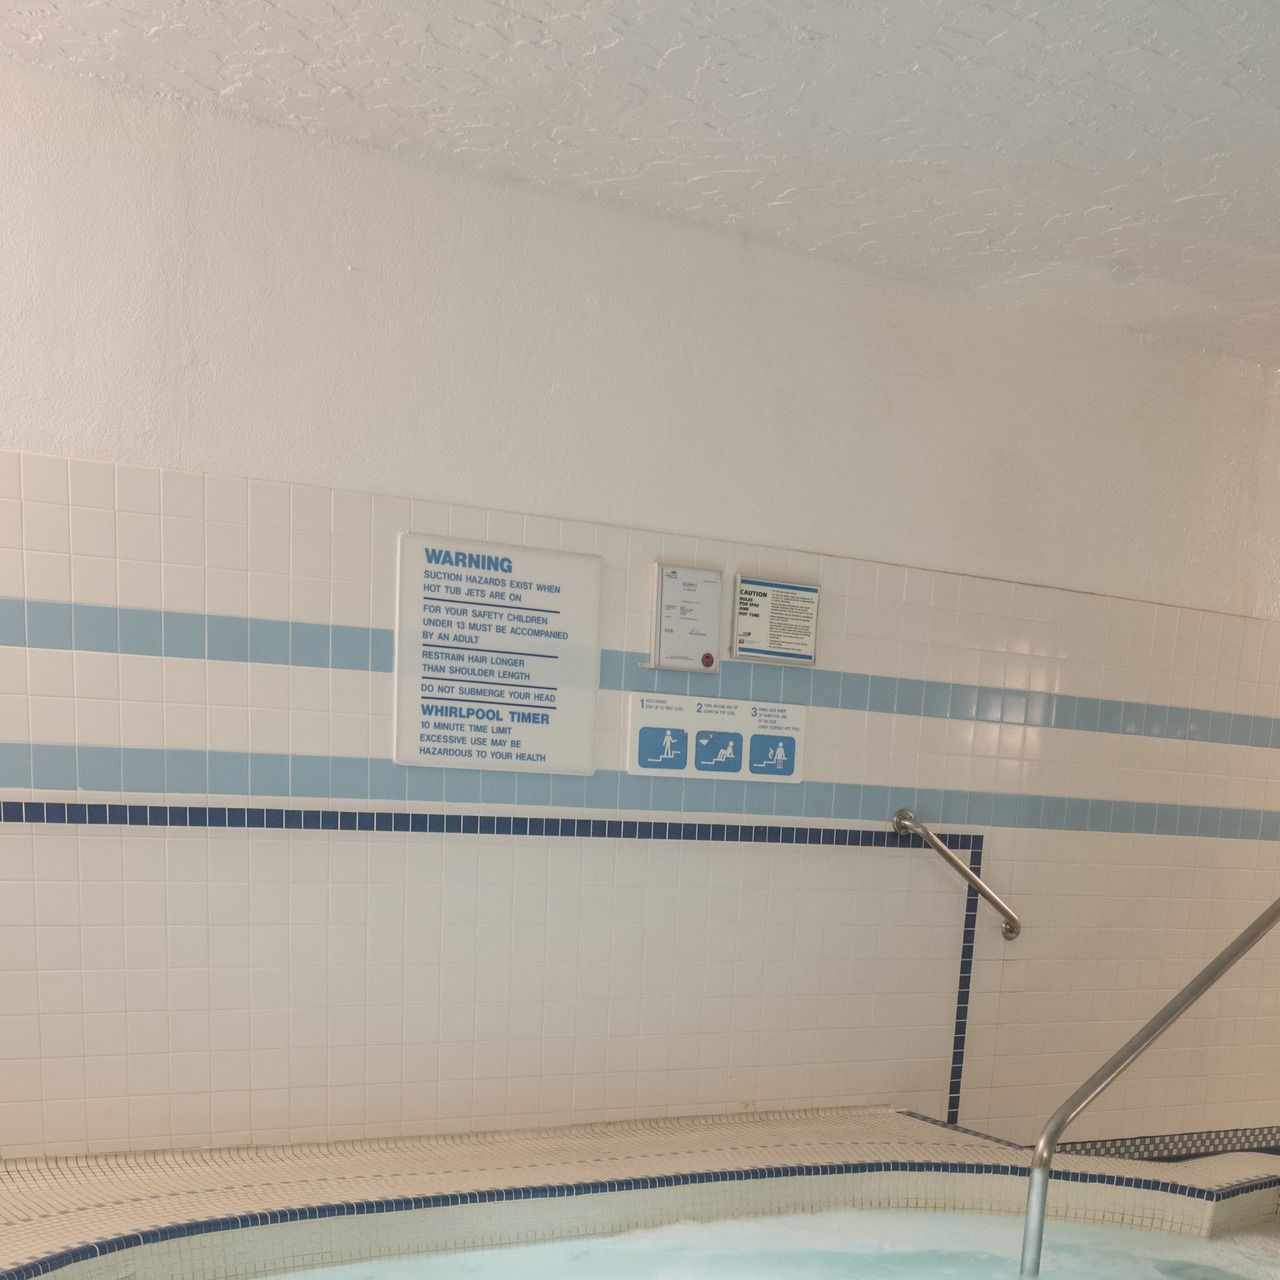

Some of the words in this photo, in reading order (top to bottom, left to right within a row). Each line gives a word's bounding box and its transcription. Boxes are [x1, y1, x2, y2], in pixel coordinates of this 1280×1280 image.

[425, 548, 513, 573] WARNING
[424, 570, 462, 582] SUCTION
[466, 575, 506, 587] HAZARDS
[510, 580, 534, 591] EXIST
[536, 584, 561, 594] WHEN
[424, 584, 440, 593] HOT
[445, 586, 461, 595] TUB
[465, 588, 486, 598] JETS
[489, 591, 505, 600] ARE
[509, 593, 522, 602] ON
[740, 589, 767, 598] CAUTION
[424, 605, 441, 614] FOR
[445, 607, 468, 617] YOUR
[472, 610, 504, 620] SAFETY
[507, 613, 548, 625] CHILDREN
[423, 618, 452, 628] UNDER
[456, 621, 465, 630] 13
[468, 623, 492, 633] MUST
[495, 625, 507, 634] BE
[510, 627, 568, 640] ACCOMPANIED
[423, 631, 435, 639] BY
[437, 632, 450, 641] AN
[453, 634, 479, 644] ADULT
[422, 650, 464, 662] RESTRAIN
[468, 655, 487, 664] HAIR
[491, 657, 525, 667] LONGER
[423, 664, 445, 674] THAN
[449, 666, 494, 678] SHOULDER
[498, 670, 530, 680] LENGTH
[421, 684, 434, 692] DO
[437, 685, 455, 694] NOT
[459, 687, 505, 698] SUBMERGE
[509, 691, 531, 701] YOUR
[534, 693, 556, 703] HEAD
[640, 698, 644, 709] 1
[696, 703, 703, 713] 2
[421, 704, 503, 722] WHIRLPOOL
[509, 711, 550, 724] TIMER
[751, 707, 758, 717] 3
[421, 721, 430, 729] 10
[434, 722, 465, 732] MINUTE
[469, 725, 487, 734] TIME
[491, 726, 512, 735] LIMIT
[420, 734, 467, 745] EXCESSIVE
[471, 737, 487, 746] USE
[491, 738, 508, 748] MAY
[511, 740, 521, 748] BE
[419, 746, 472, 758] HAZARDOUS
[477, 750, 487, 758] TO
[490, 751, 512, 761] YOUR
[516, 753, 546, 762] HEALTH
